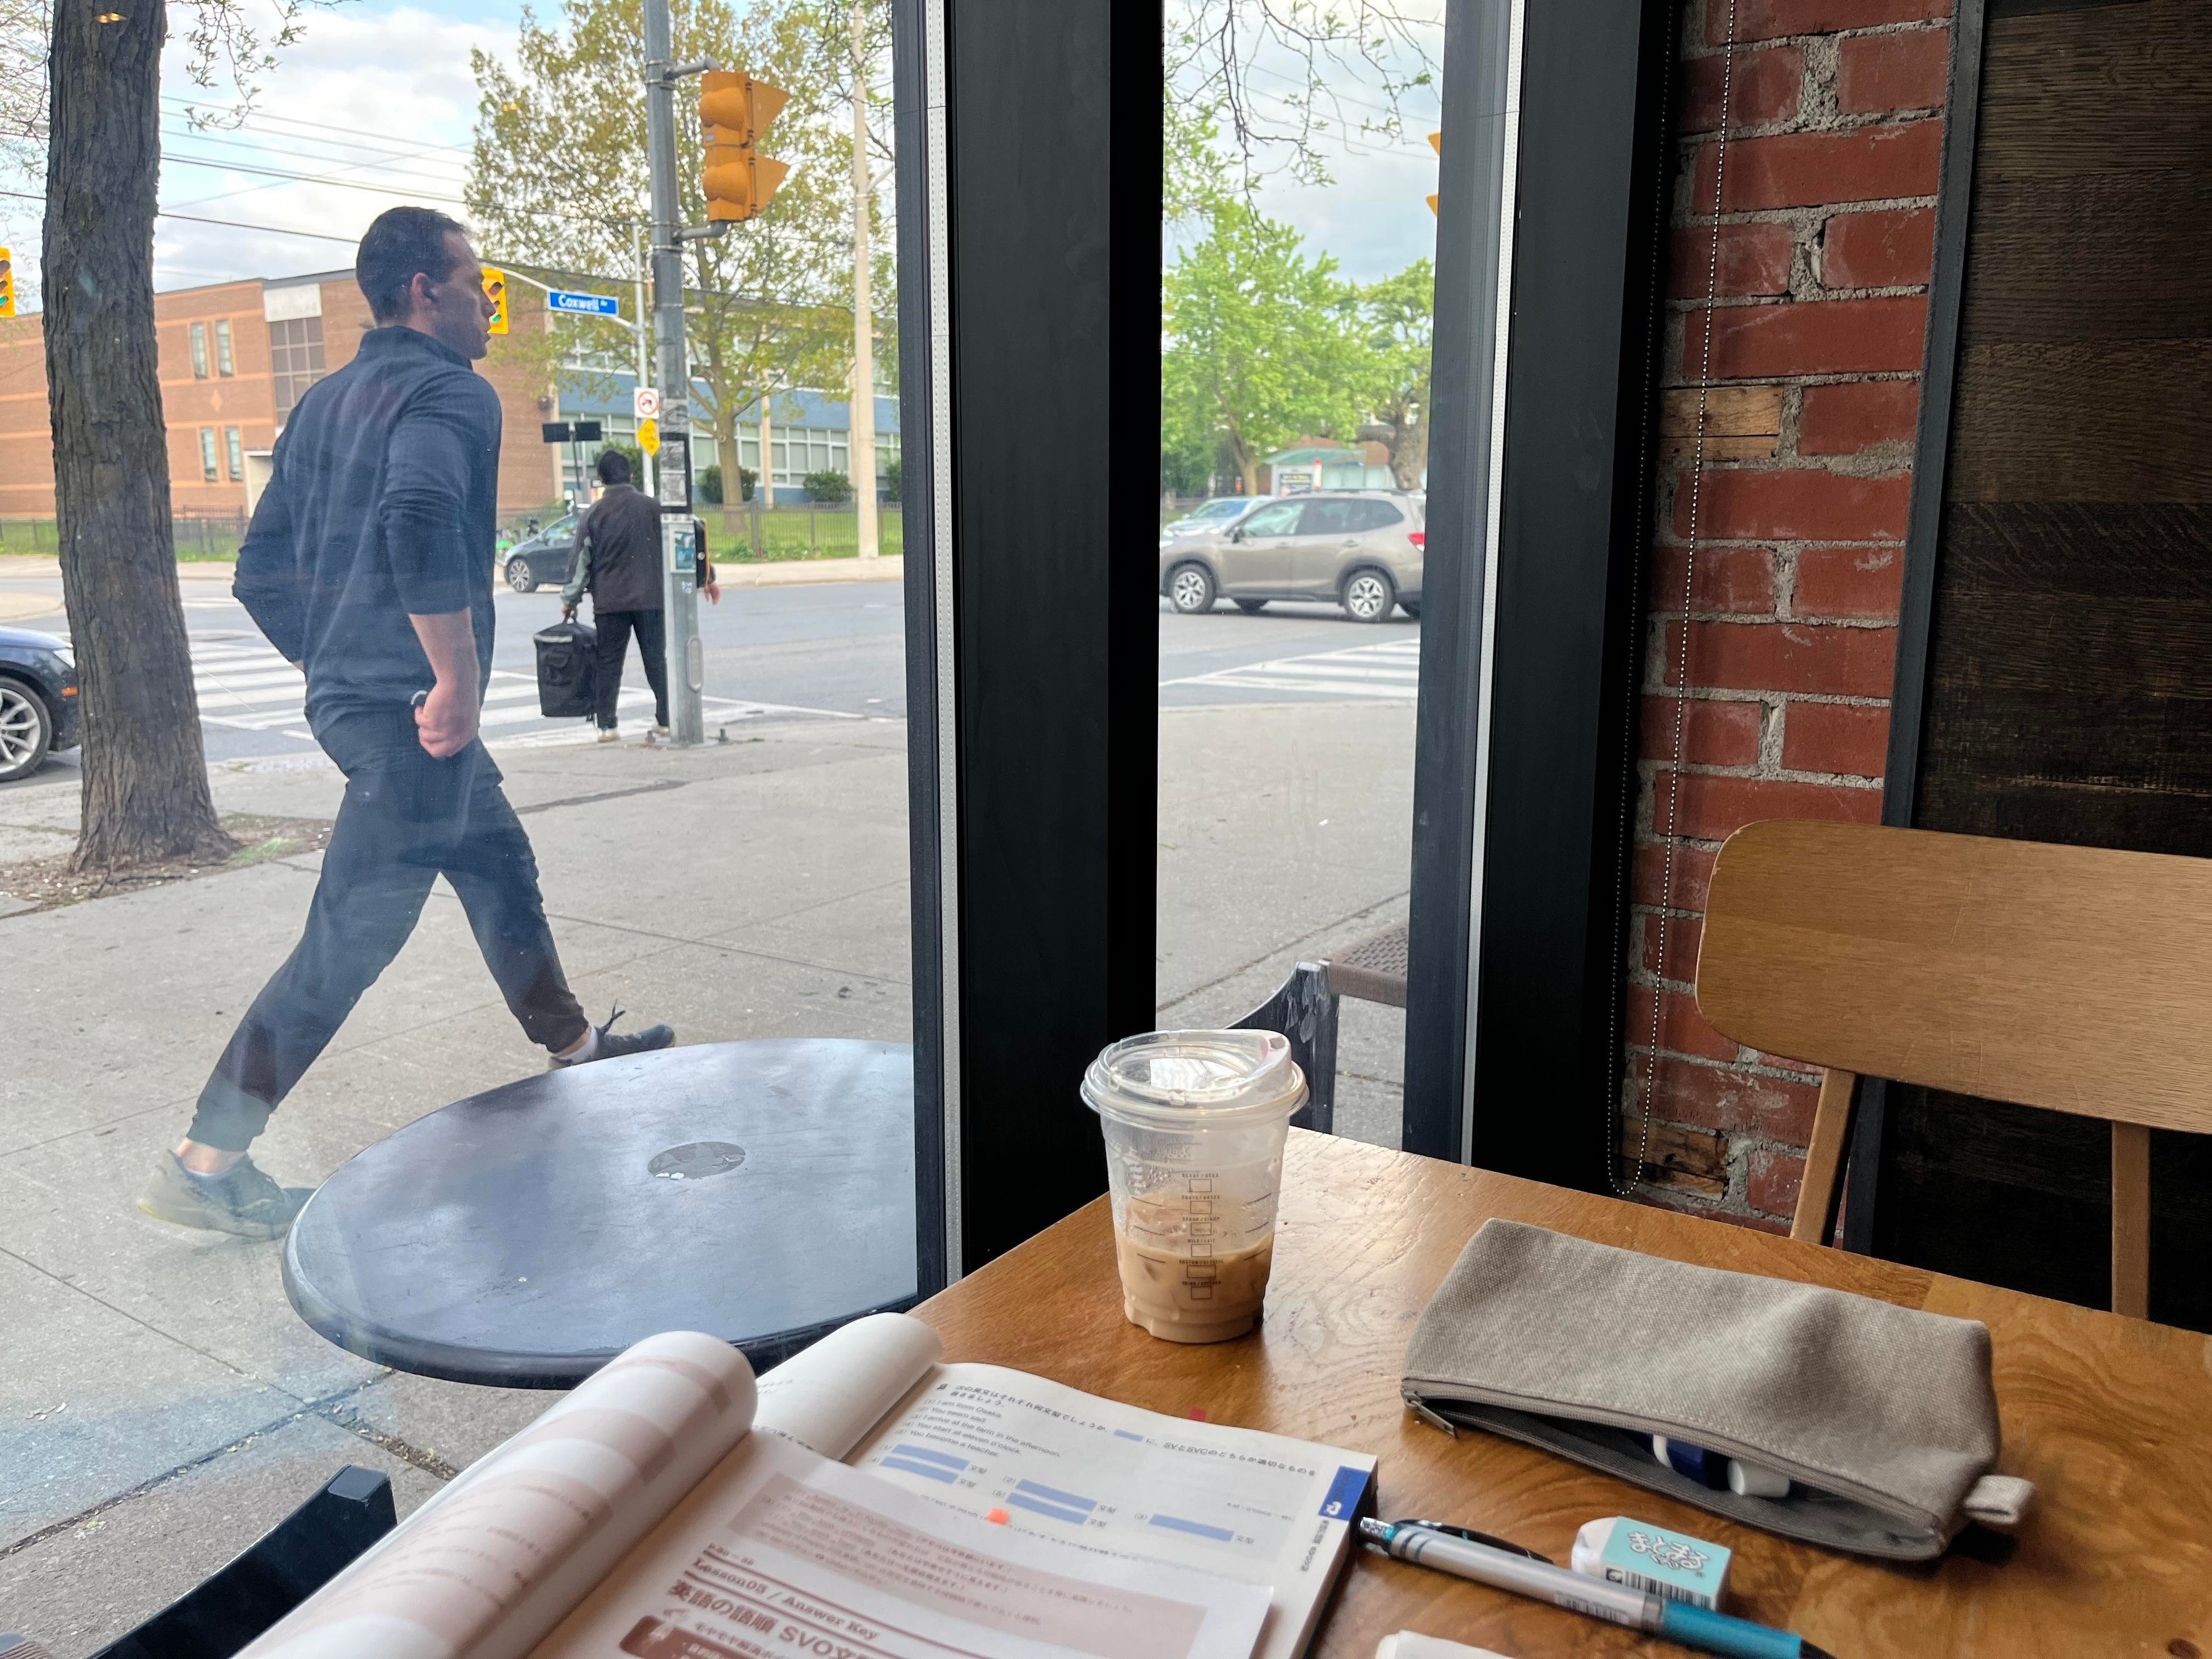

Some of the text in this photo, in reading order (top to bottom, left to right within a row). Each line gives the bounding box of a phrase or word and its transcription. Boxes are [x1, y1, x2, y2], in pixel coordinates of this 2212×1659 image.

[558, 294, 600, 311] Coxwell
[781, 1595, 845, 1626] Answer
[846, 1620, 879, 1640] Key
